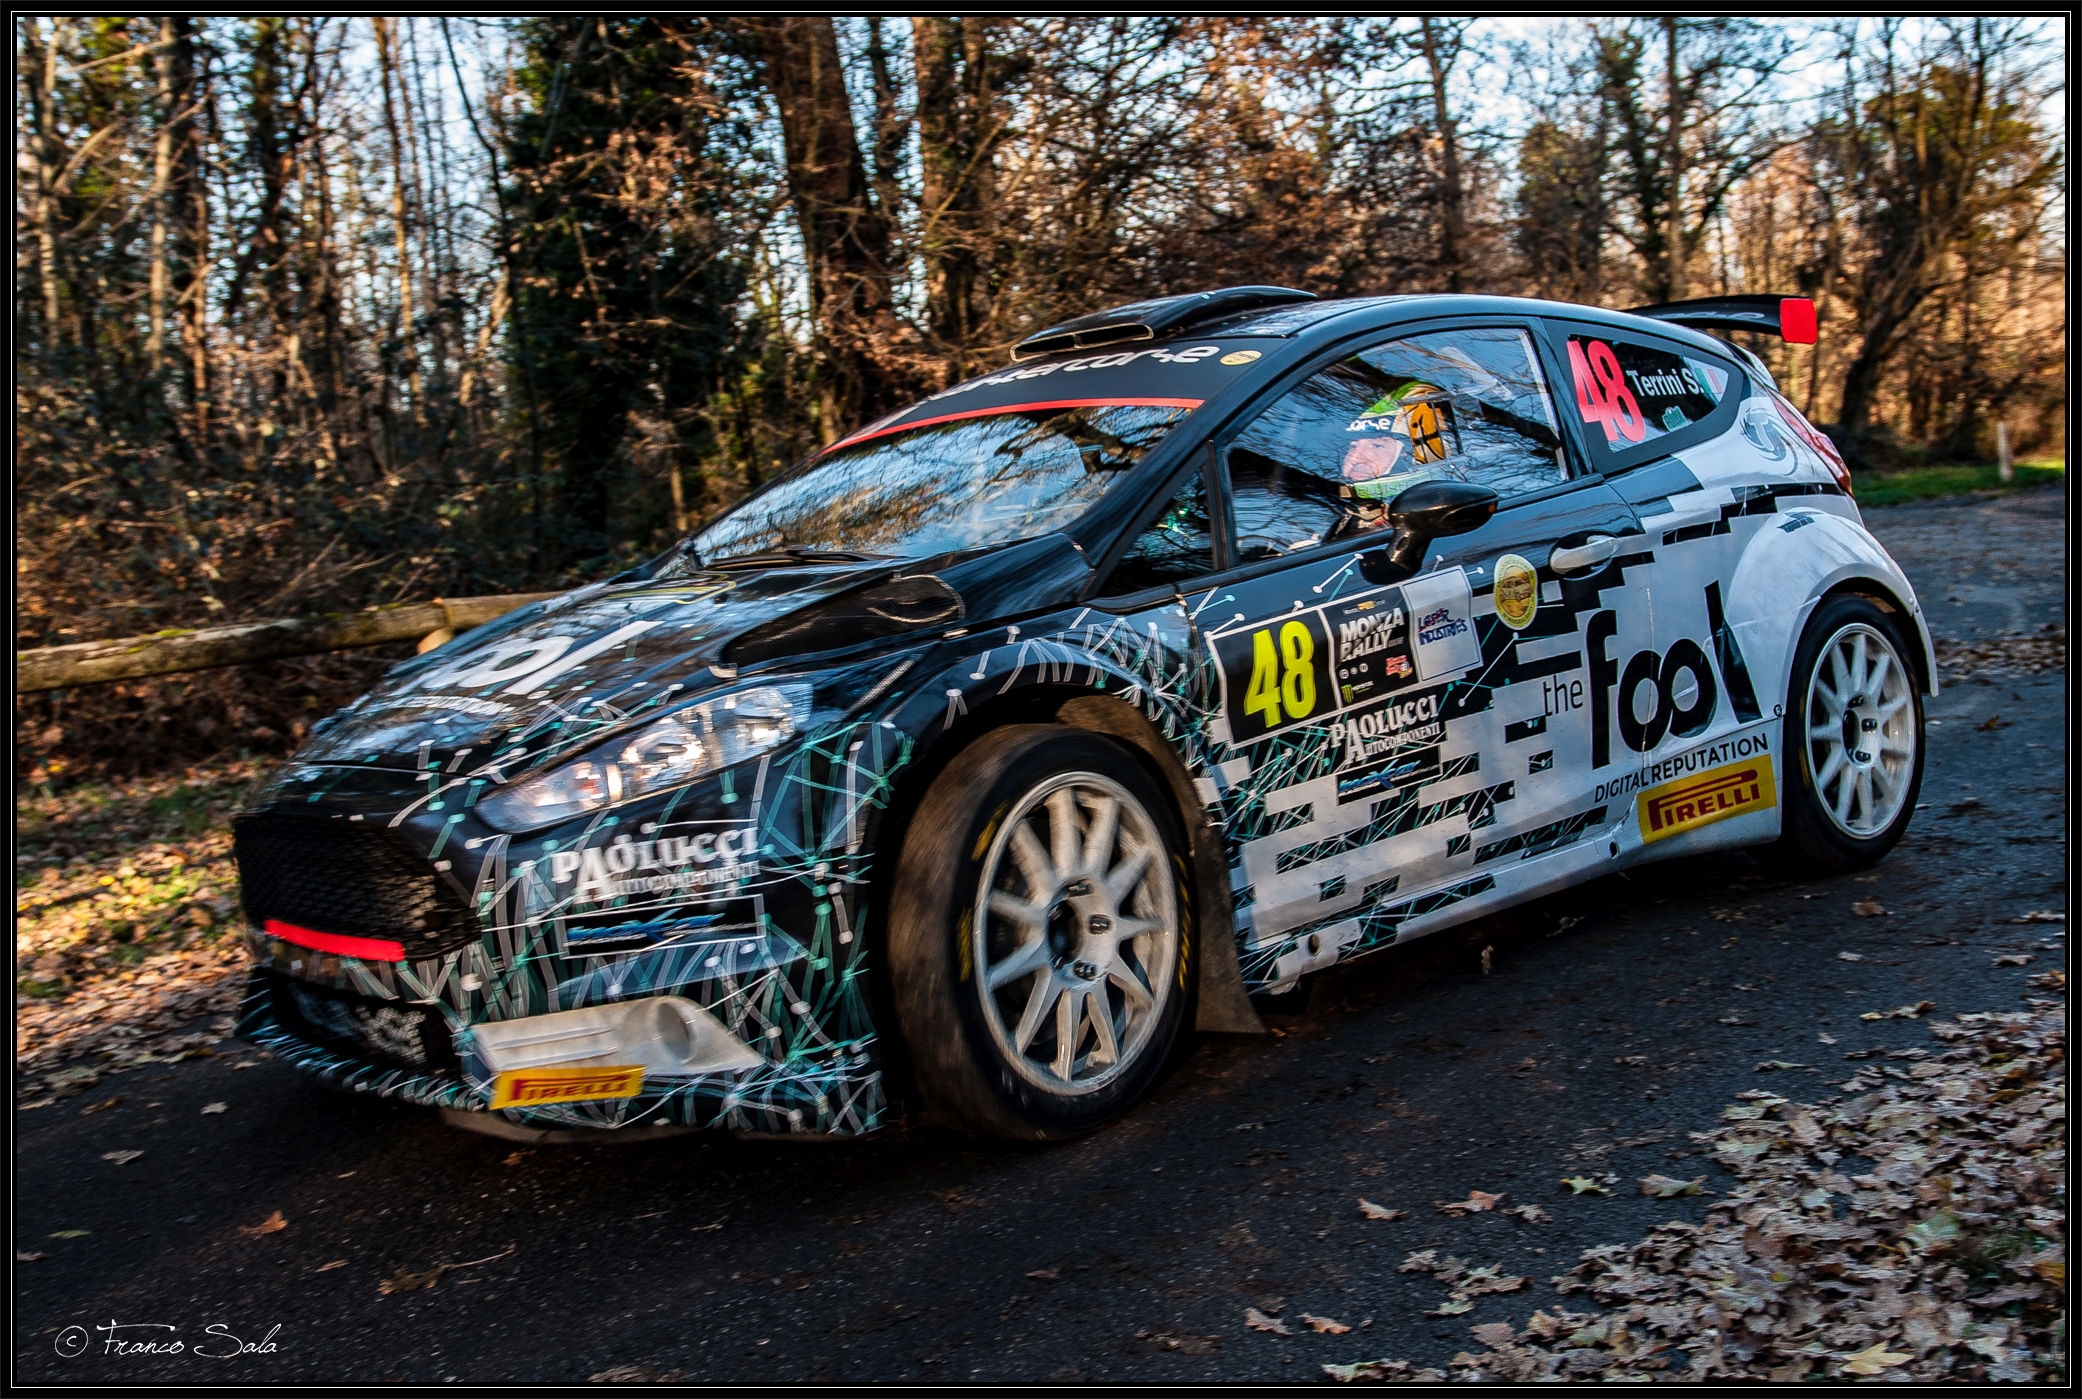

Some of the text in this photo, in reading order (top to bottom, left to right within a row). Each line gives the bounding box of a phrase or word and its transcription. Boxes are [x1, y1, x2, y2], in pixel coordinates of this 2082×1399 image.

[1566, 340, 1646, 442] 48
[1625, 367, 1704, 397] Terrini S.
[1338, 629, 1394, 663] RALLY
[1339, 607, 1405, 643] MONZA
[1418, 617, 1468, 648] INDUSTRIES
[1243, 620, 1317, 728] 48
[1543, 674, 1584, 717] the
[1586, 579, 1764, 770] fool
[1328, 694, 1440, 764] PAOLUCCI
[1594, 733, 1769, 803] DIGITAL REPUTATION
[1648, 769, 1761, 832] PIRELLI
[551, 826, 760, 900] PAOLUCCI
[510, 1074, 634, 1100] PIRELLI
